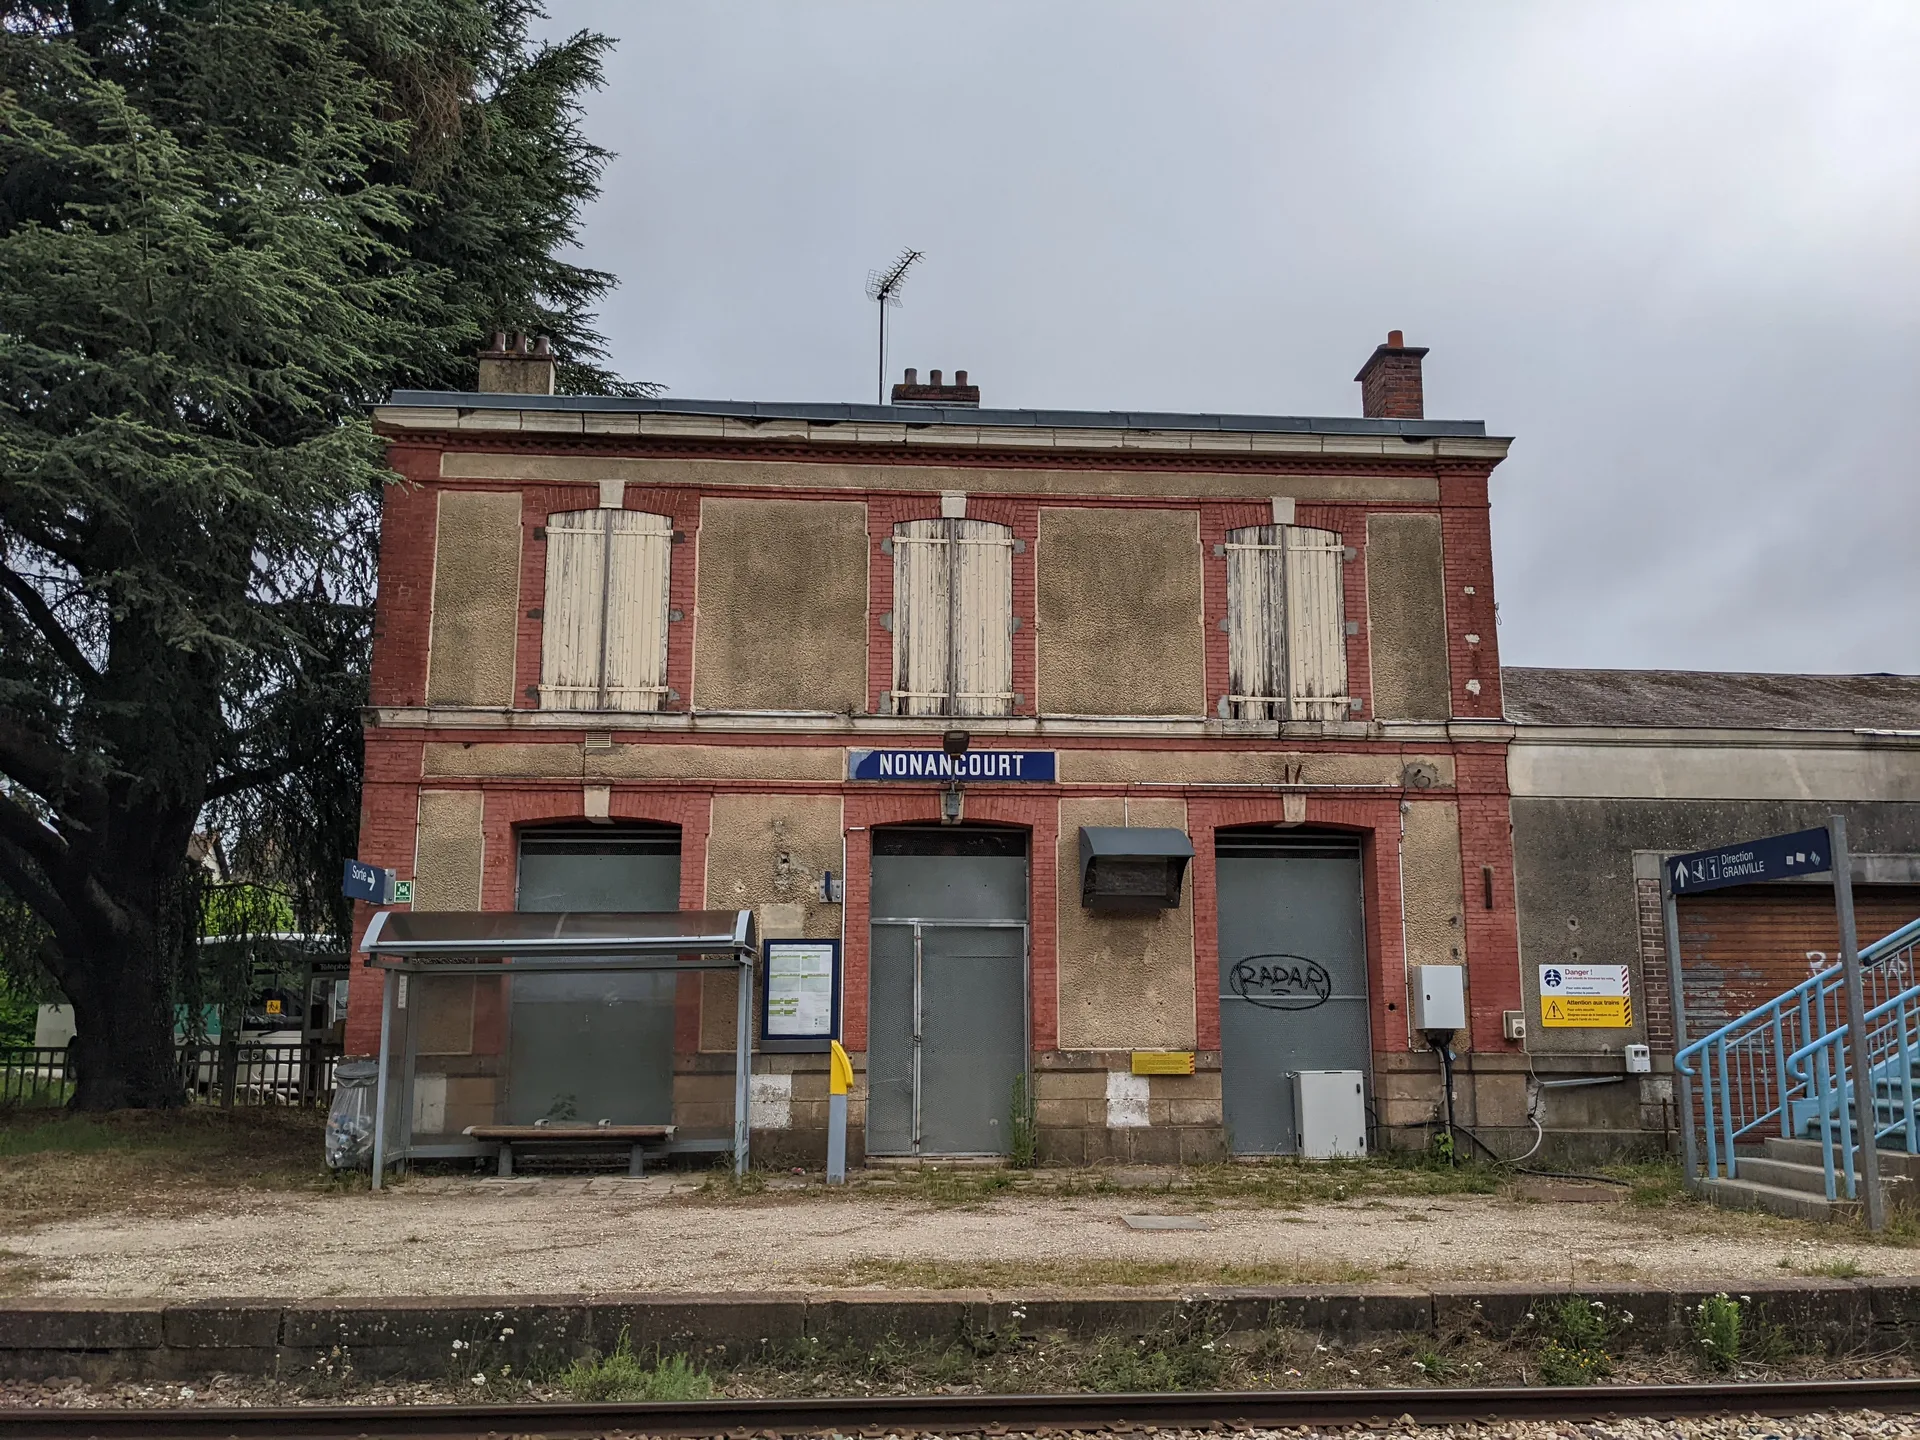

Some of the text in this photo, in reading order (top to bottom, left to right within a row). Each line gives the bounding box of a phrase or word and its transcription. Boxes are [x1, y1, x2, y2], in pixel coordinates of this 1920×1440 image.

[879, 753, 1024, 776] NONANCOURT
[1721, 851, 1754, 865] Direction
[352, 865, 367, 881] Sortie
[1710, 864, 1716, 878] 1
[1722, 860, 1765, 878] GRANVILLE
[1236, 965, 1326, 999] RADAR
